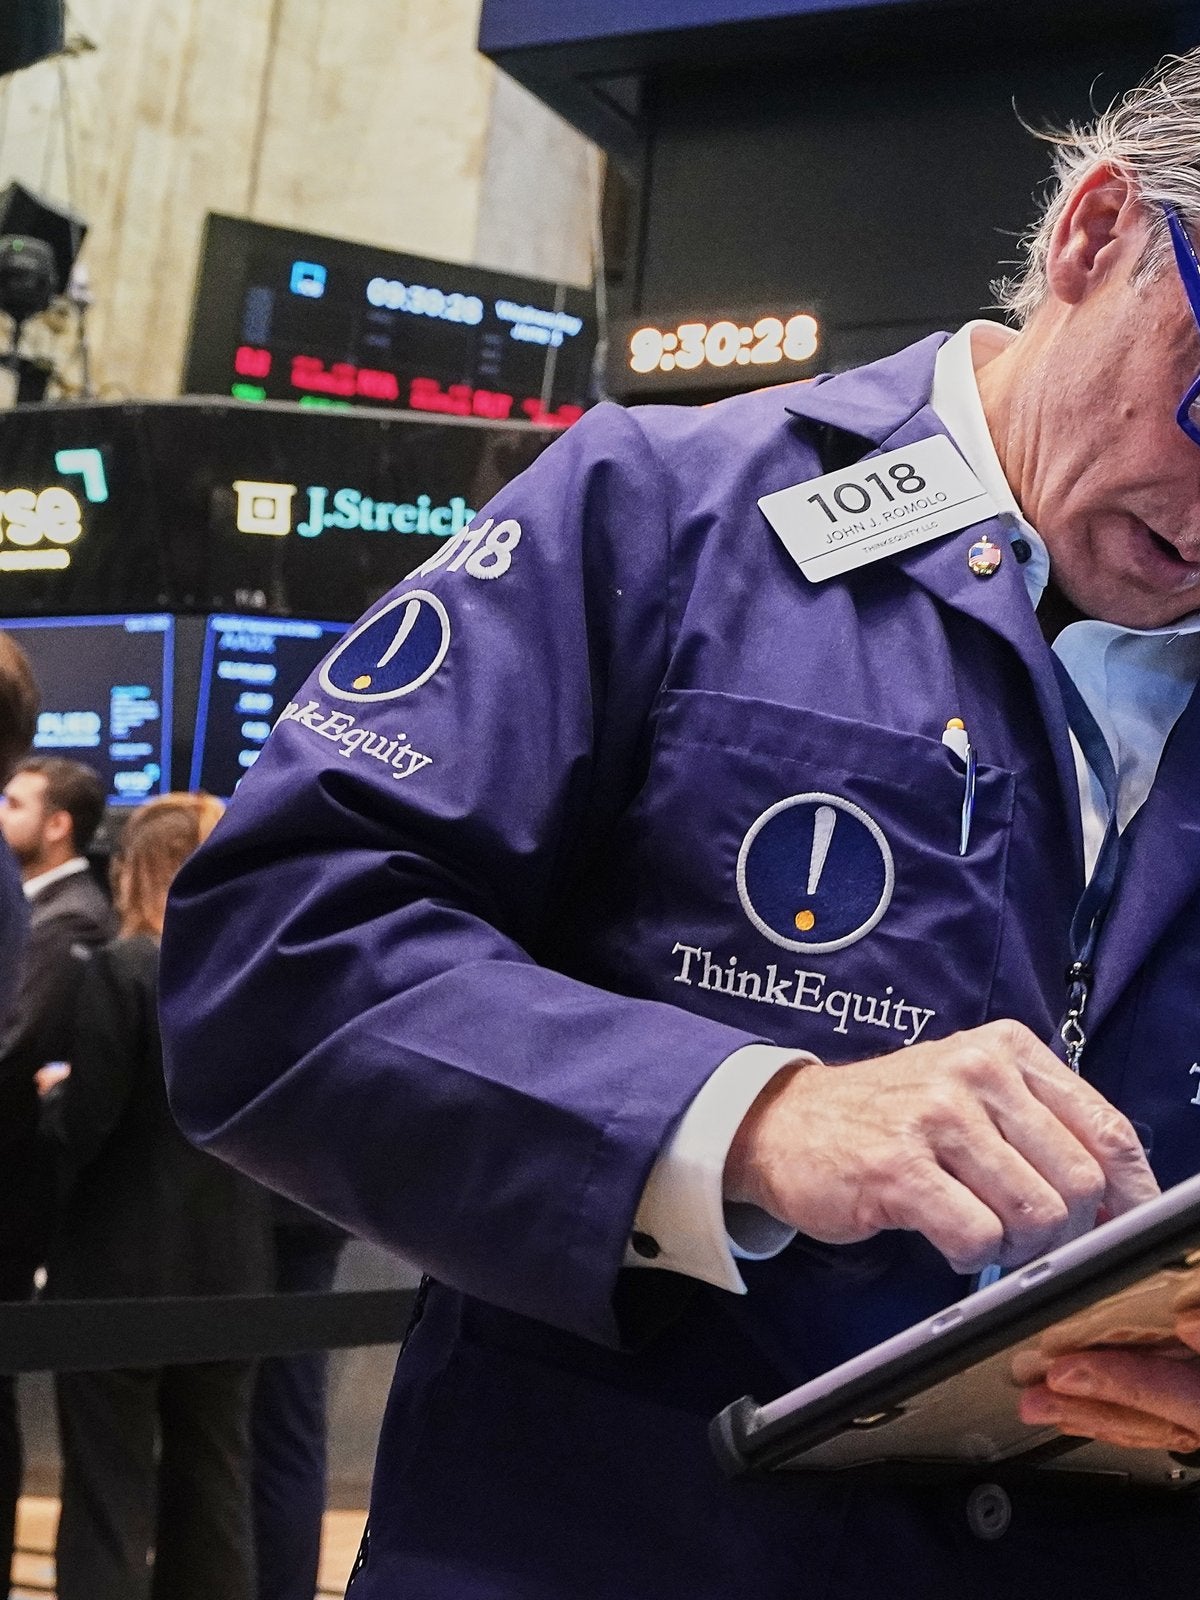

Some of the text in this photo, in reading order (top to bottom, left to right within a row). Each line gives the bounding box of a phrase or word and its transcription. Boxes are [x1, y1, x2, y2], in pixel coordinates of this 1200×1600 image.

[630, 314, 818, 373] 9:30:28
[807, 463, 926, 523] 1018
[826, 491, 948, 545] JOHN J. ROMOLO
[271, 701, 433, 780] nkEquity
[671, 941, 936, 1046] ThinkEquity
